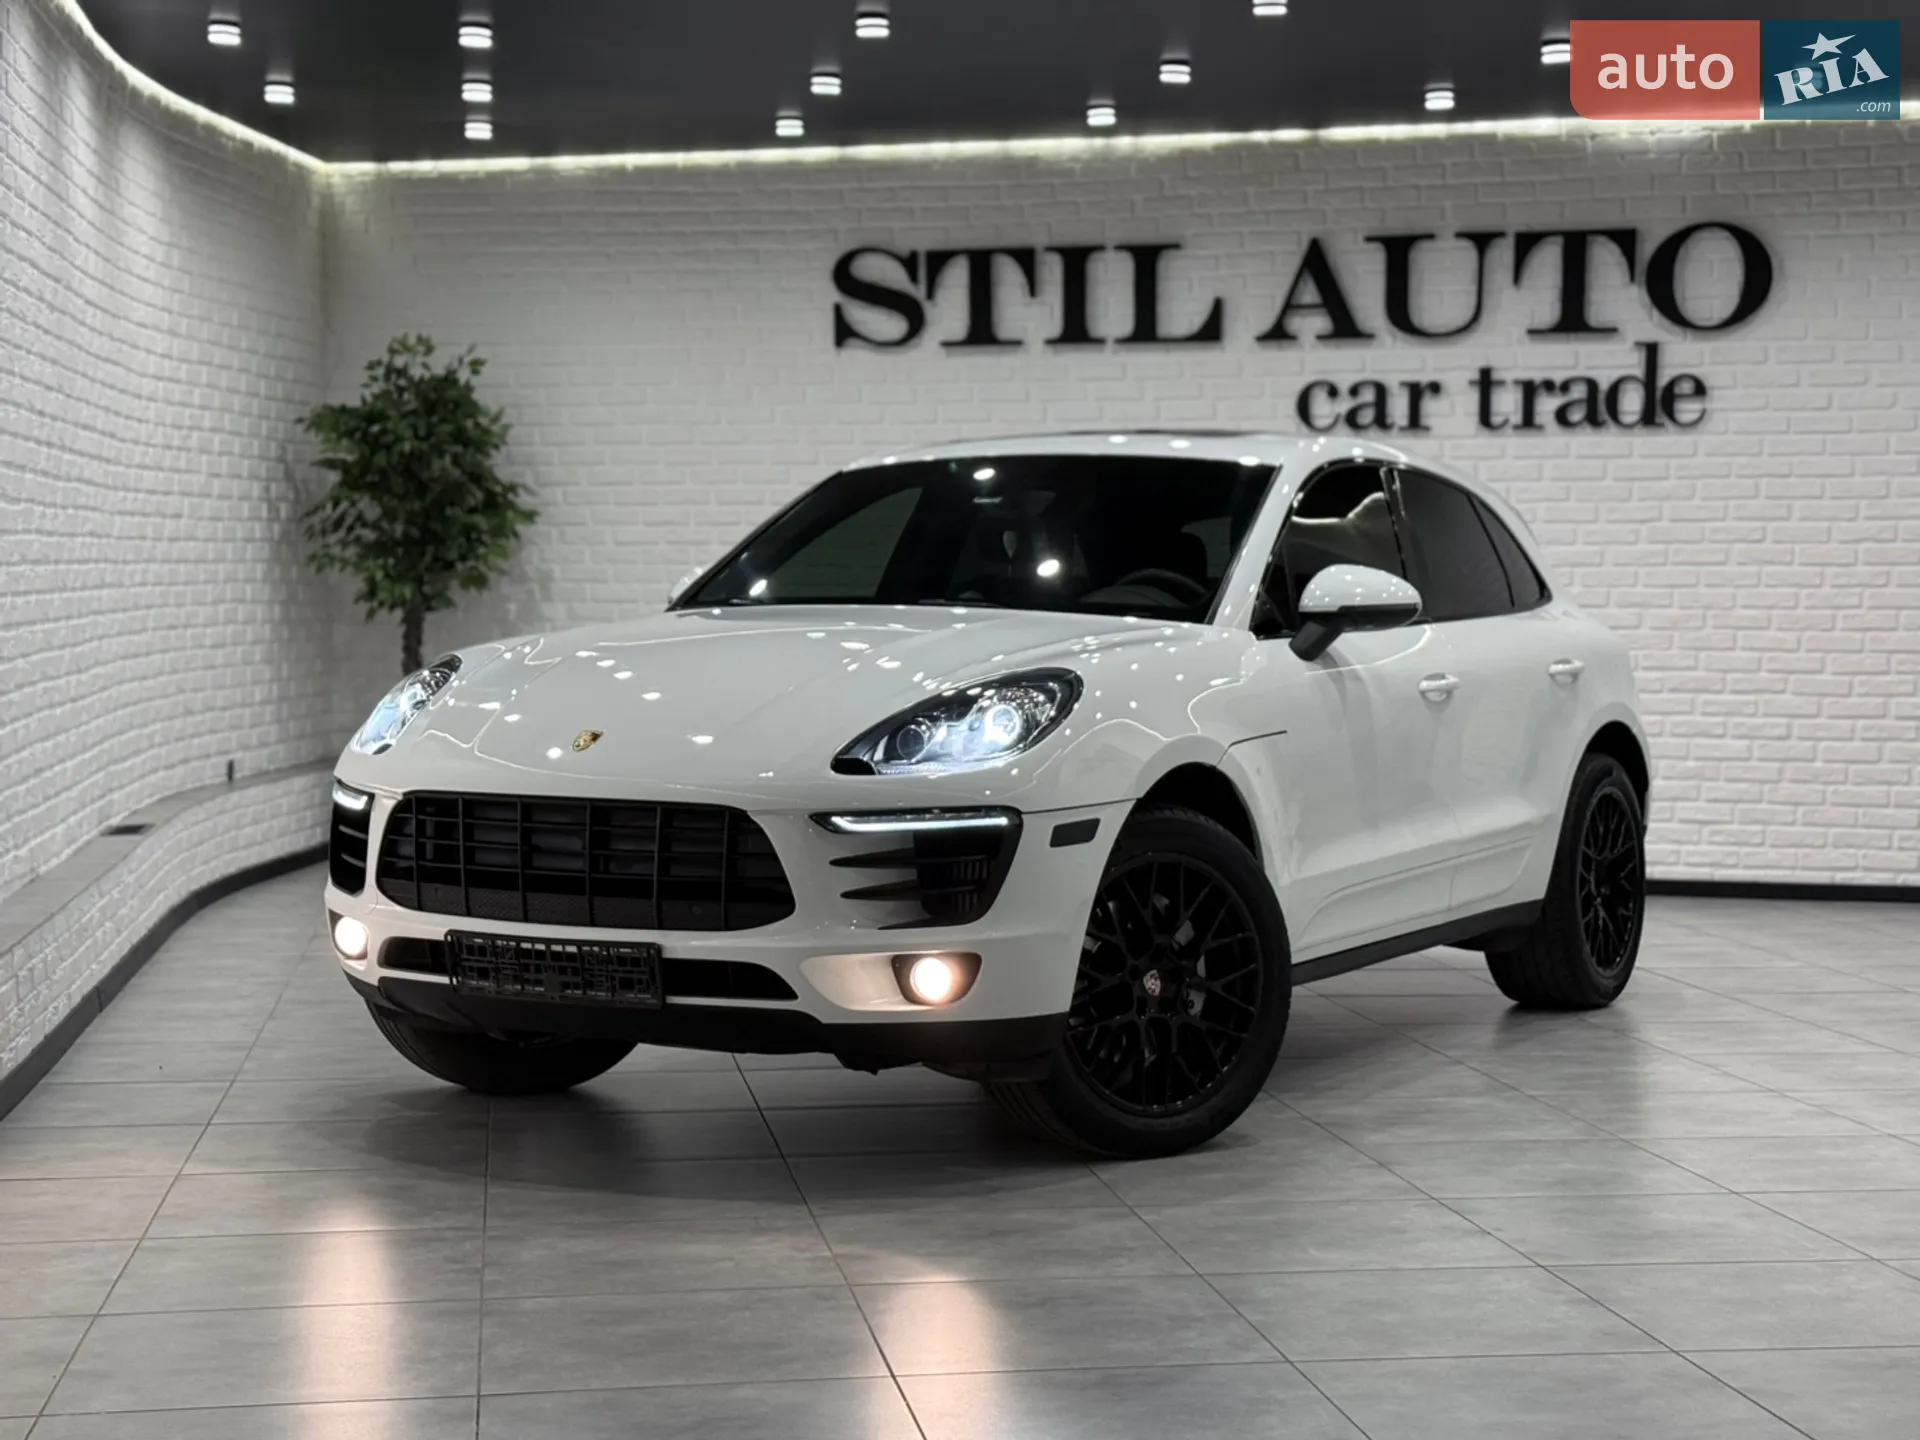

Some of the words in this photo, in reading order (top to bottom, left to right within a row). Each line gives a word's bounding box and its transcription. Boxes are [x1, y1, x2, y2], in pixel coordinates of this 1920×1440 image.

[832, 243, 1223, 348] STIL
[1255, 222, 1773, 342] AUTO
[1297, 378, 1442, 431] car
[1468, 342, 1707, 429] trade
